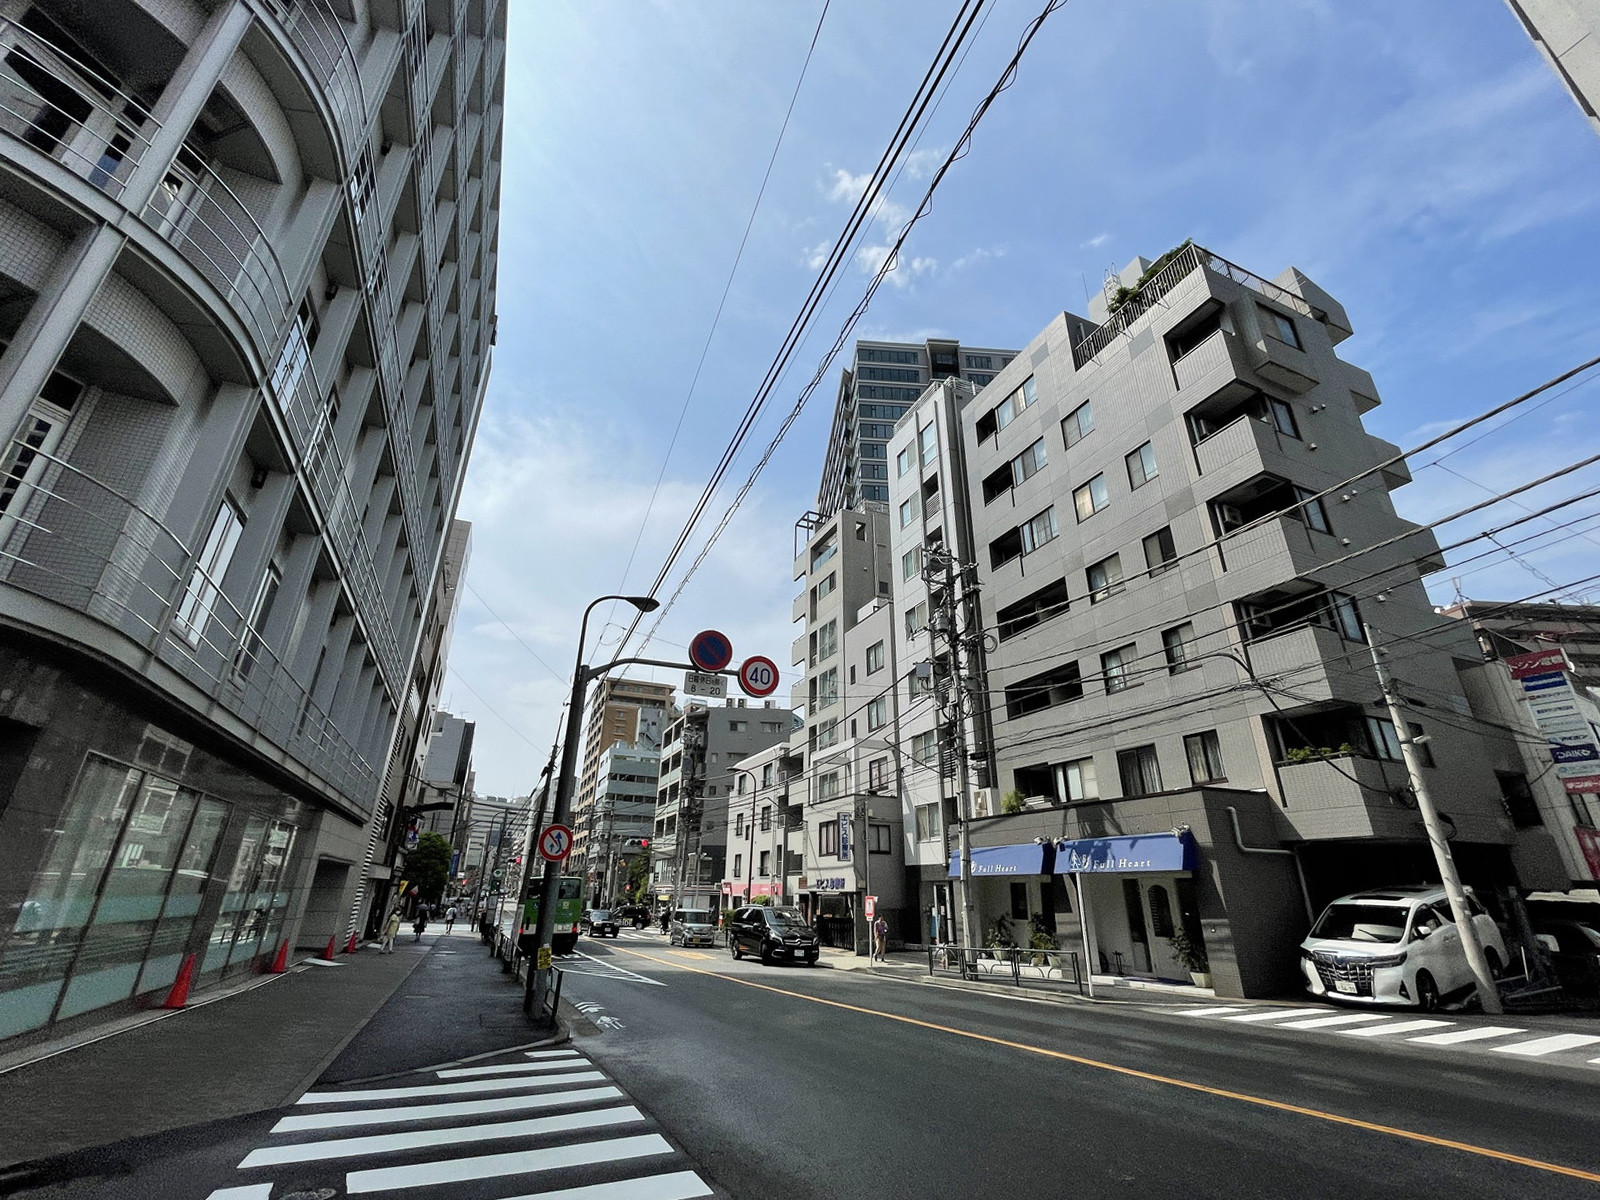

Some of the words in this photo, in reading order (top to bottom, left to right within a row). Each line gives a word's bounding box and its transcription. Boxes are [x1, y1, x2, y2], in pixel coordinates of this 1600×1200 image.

[749, 666, 771, 685] 40
[690, 684, 697, 692] 8
[710, 687, 721, 695] 20
[995, 864, 1017, 873] Heart
[1093, 859, 1115, 869] Full
[1118, 858, 1151, 868] Heart
